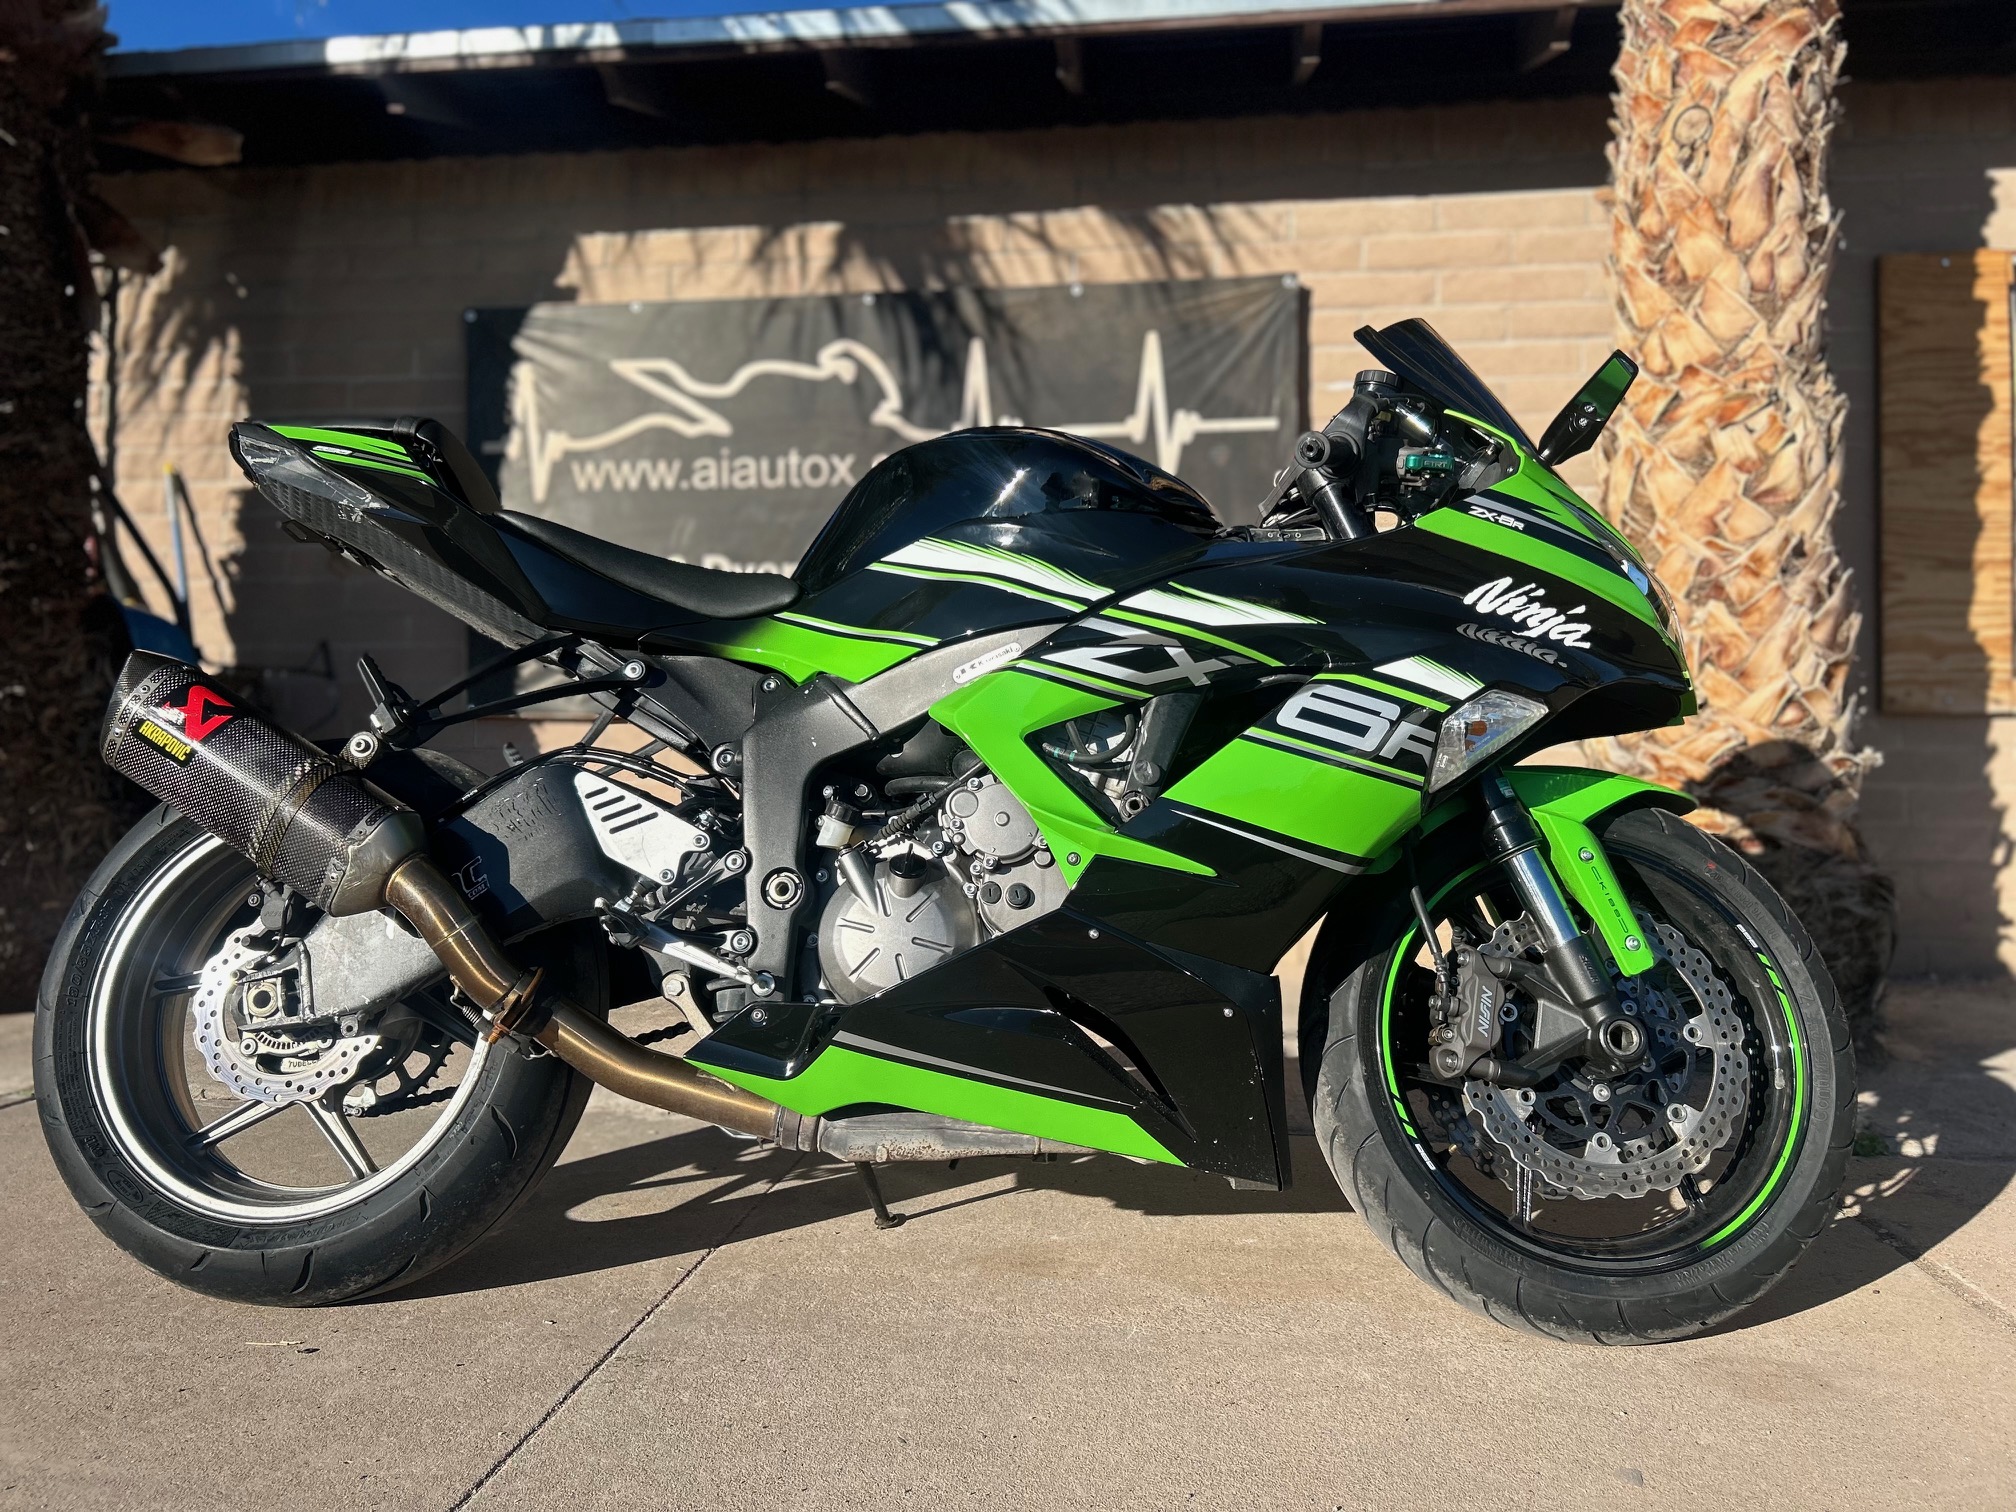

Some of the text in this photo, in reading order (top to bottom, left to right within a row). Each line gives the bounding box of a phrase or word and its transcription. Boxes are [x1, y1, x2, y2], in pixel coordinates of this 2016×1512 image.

[570, 447, 888, 493] www.aiautox
[1463, 577, 1591, 649] Ninja
[1477, 985, 1493, 1038] NISSIN
